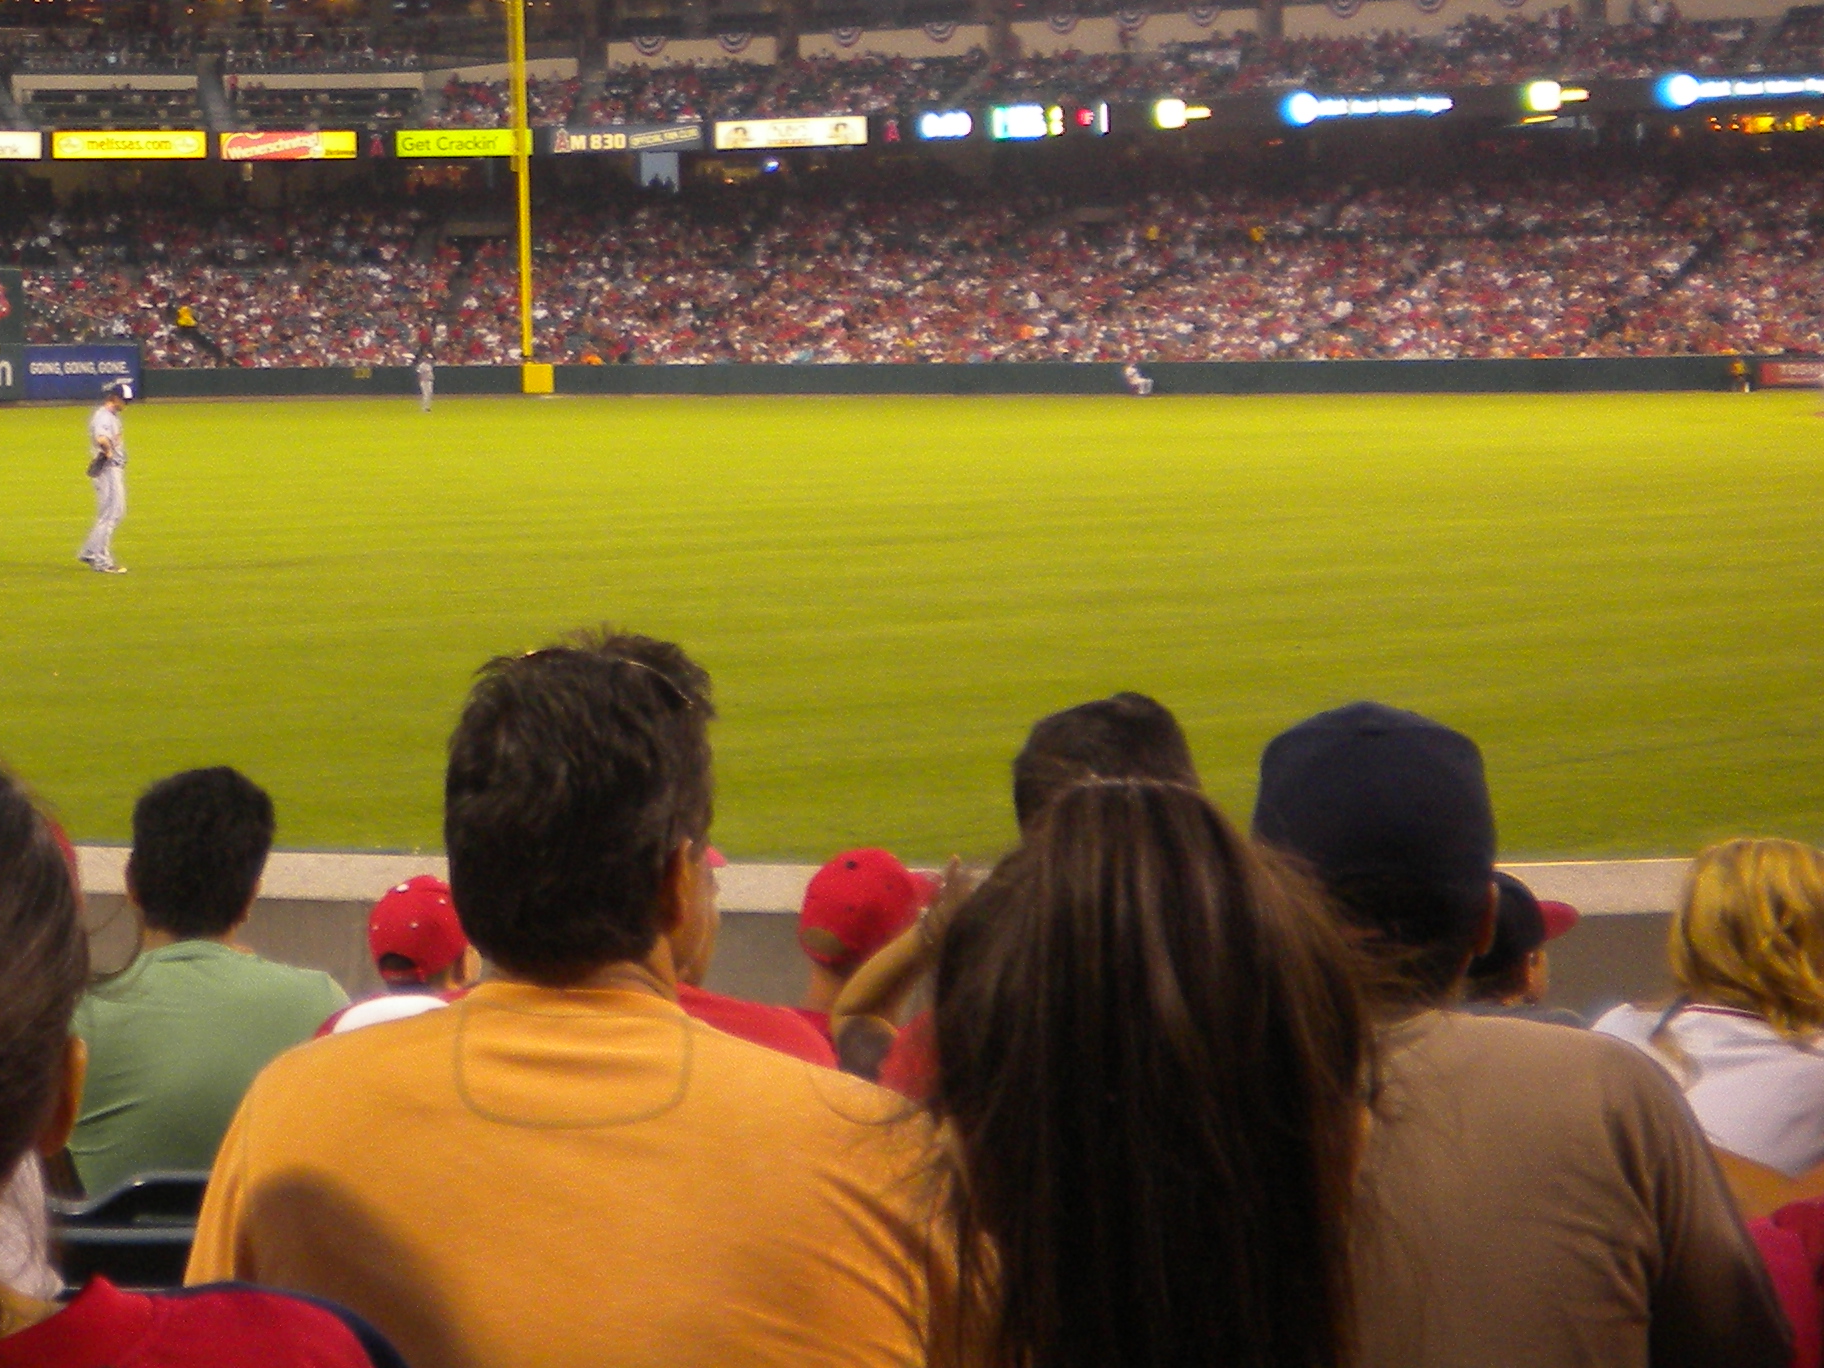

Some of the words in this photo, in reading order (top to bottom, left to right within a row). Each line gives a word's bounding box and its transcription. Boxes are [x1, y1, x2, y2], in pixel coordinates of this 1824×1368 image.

[401, 136, 433, 152] Get
[435, 135, 499, 151] Crackin'
[590, 133, 626, 151] 830
